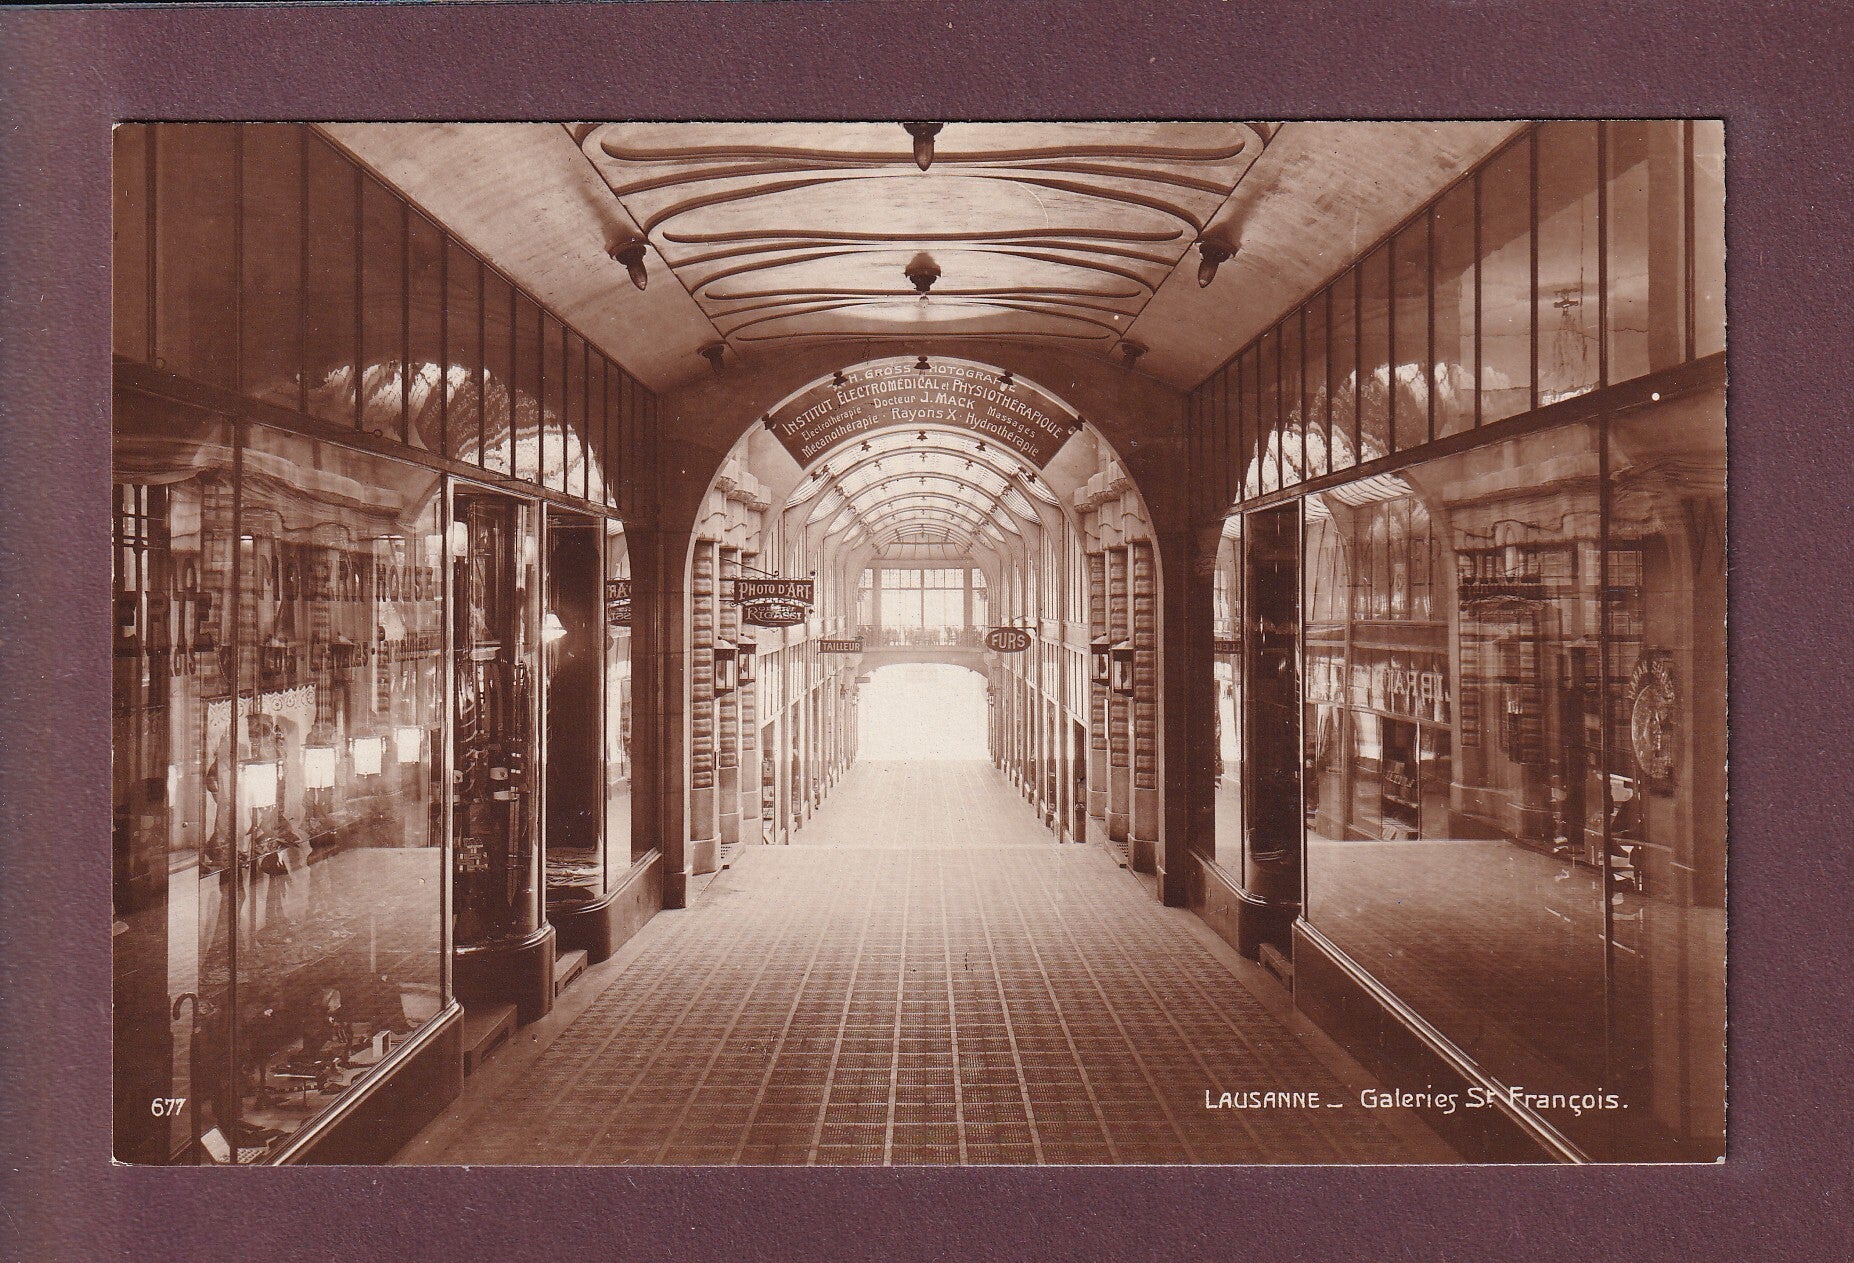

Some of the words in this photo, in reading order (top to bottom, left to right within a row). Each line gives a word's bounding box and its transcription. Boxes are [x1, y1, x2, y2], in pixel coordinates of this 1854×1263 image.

[864, 364, 911, 379] GROSS
[782, 399, 833, 436] INSTITUT
[941, 381, 949, 391] et
[873, 394, 916, 409] Docteur
[935, 393, 976, 410] MACK
[892, 407, 944, 422] Rayons
[946, 408, 957, 421] X
[987, 406, 1037, 438] Massages
[739, 582, 775, 601] PHOTO
[778, 582, 812, 600] D'ART
[823, 642, 860, 652] TAILLEUR
[991, 632, 1026, 650] FURS
